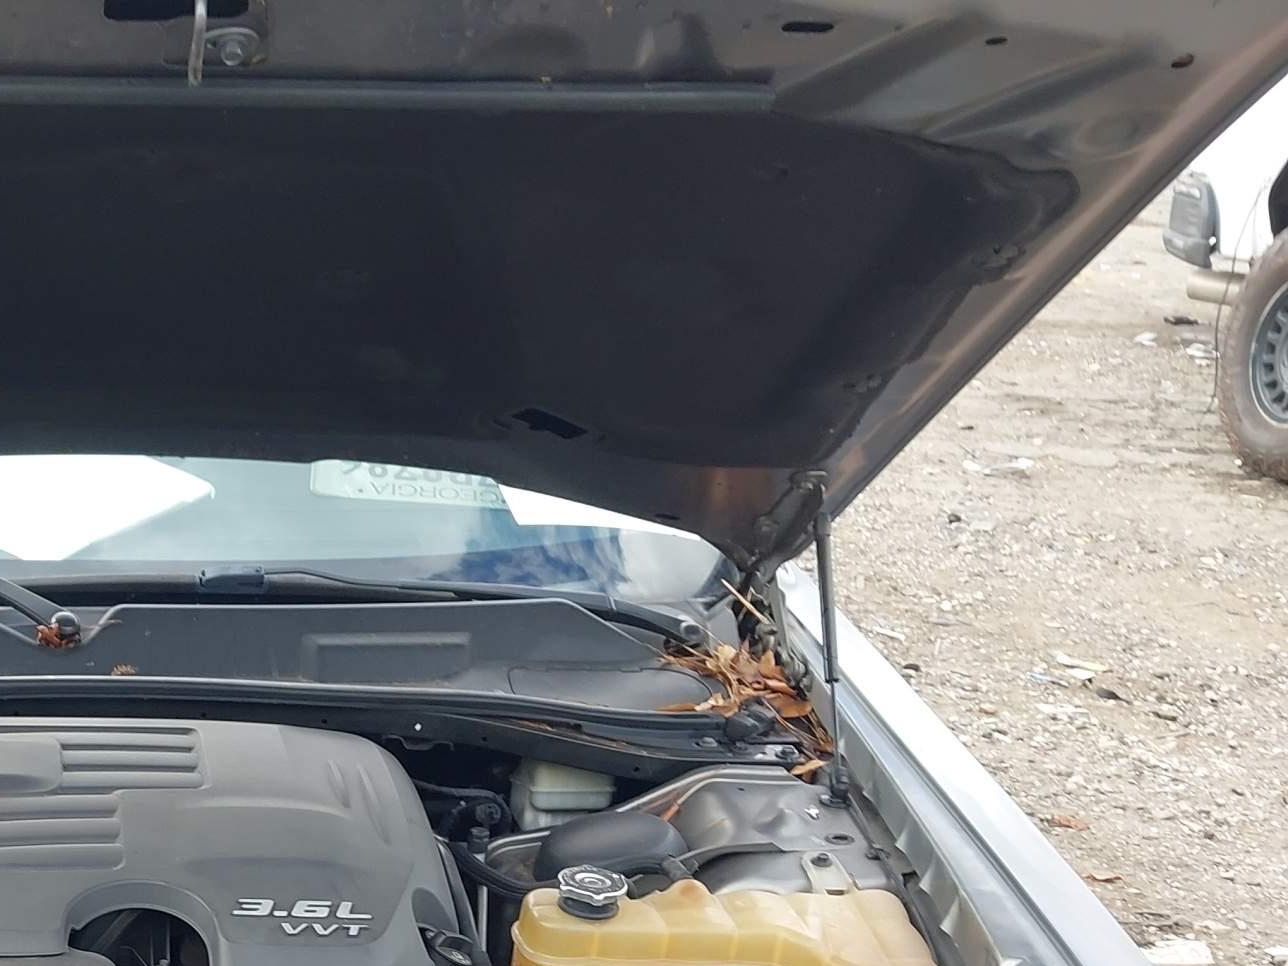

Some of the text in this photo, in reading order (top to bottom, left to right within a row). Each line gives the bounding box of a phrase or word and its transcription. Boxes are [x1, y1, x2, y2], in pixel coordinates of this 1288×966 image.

[369, 481, 499, 504] GEORGIA
[232, 898, 373, 919] 3.6L
[280, 922, 369, 936] VVT
